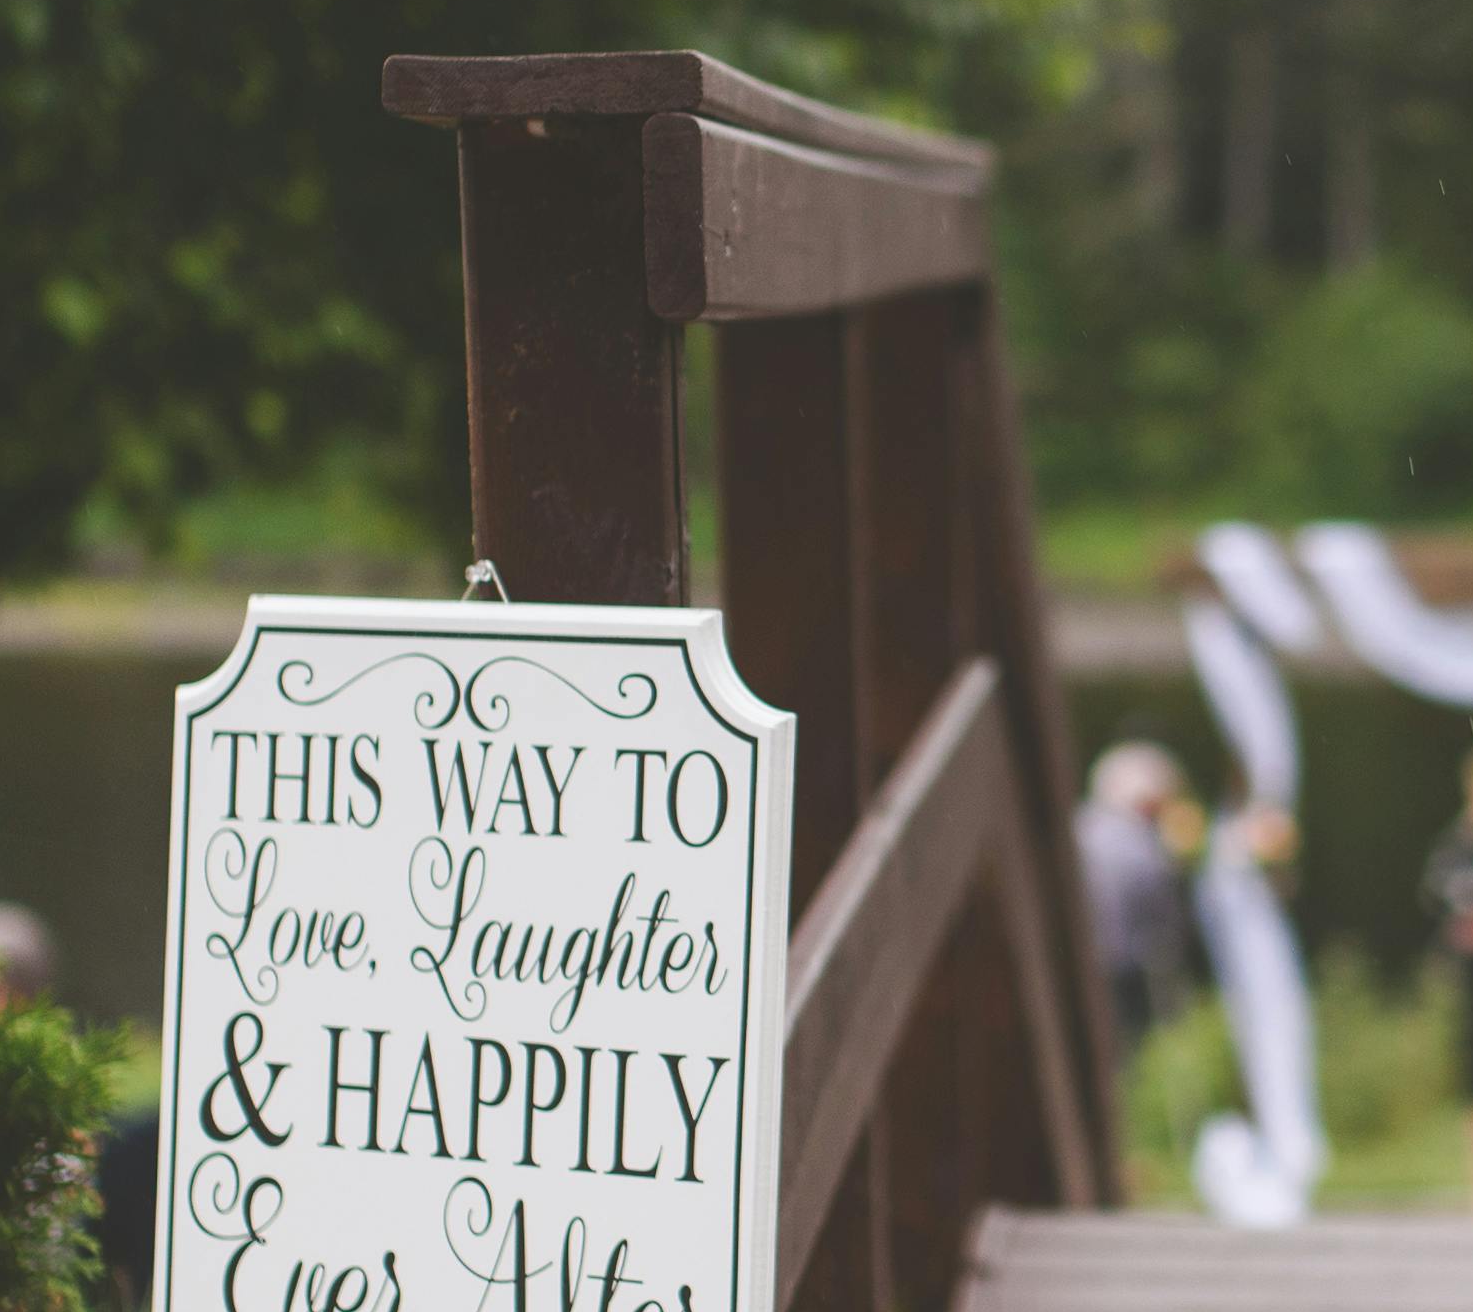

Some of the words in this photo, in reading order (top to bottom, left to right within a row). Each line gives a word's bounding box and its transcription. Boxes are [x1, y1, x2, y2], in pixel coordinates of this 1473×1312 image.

[212, 730, 383, 829] THIS
[422, 737, 587, 838] WAY
[614, 748, 731, 848] TO
[204, 829, 378, 1006] Love,
[408, 836, 728, 1032] Laughter
[199, 1011, 294, 1148] &
[317, 1025, 731, 1184] HAPPILY
